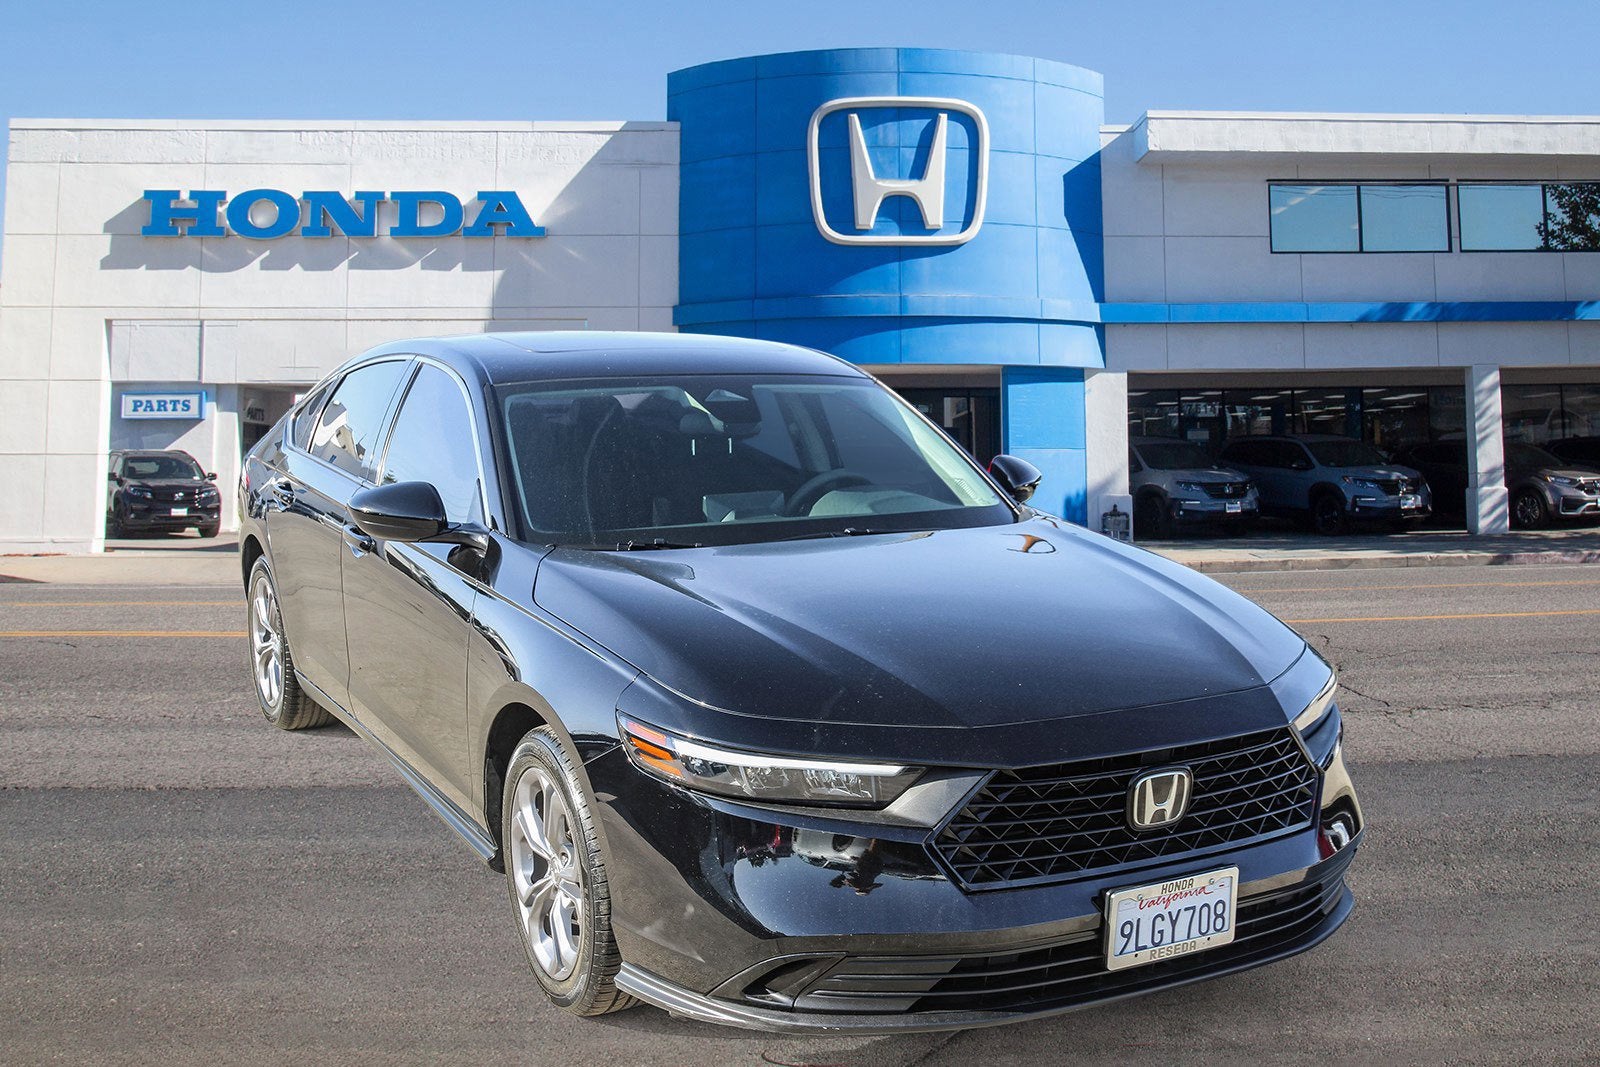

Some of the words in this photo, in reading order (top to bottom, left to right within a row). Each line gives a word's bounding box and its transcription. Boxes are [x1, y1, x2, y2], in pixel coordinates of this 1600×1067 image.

[141, 188, 547, 240] HONDA
[132, 399, 192, 413] PARTS
[1138, 885, 1213, 911] California
[1161, 878, 1194, 895] HONDA
[1119, 899, 1226, 956] 9LGY708
[1149, 940, 1197, 961] RESEDA
